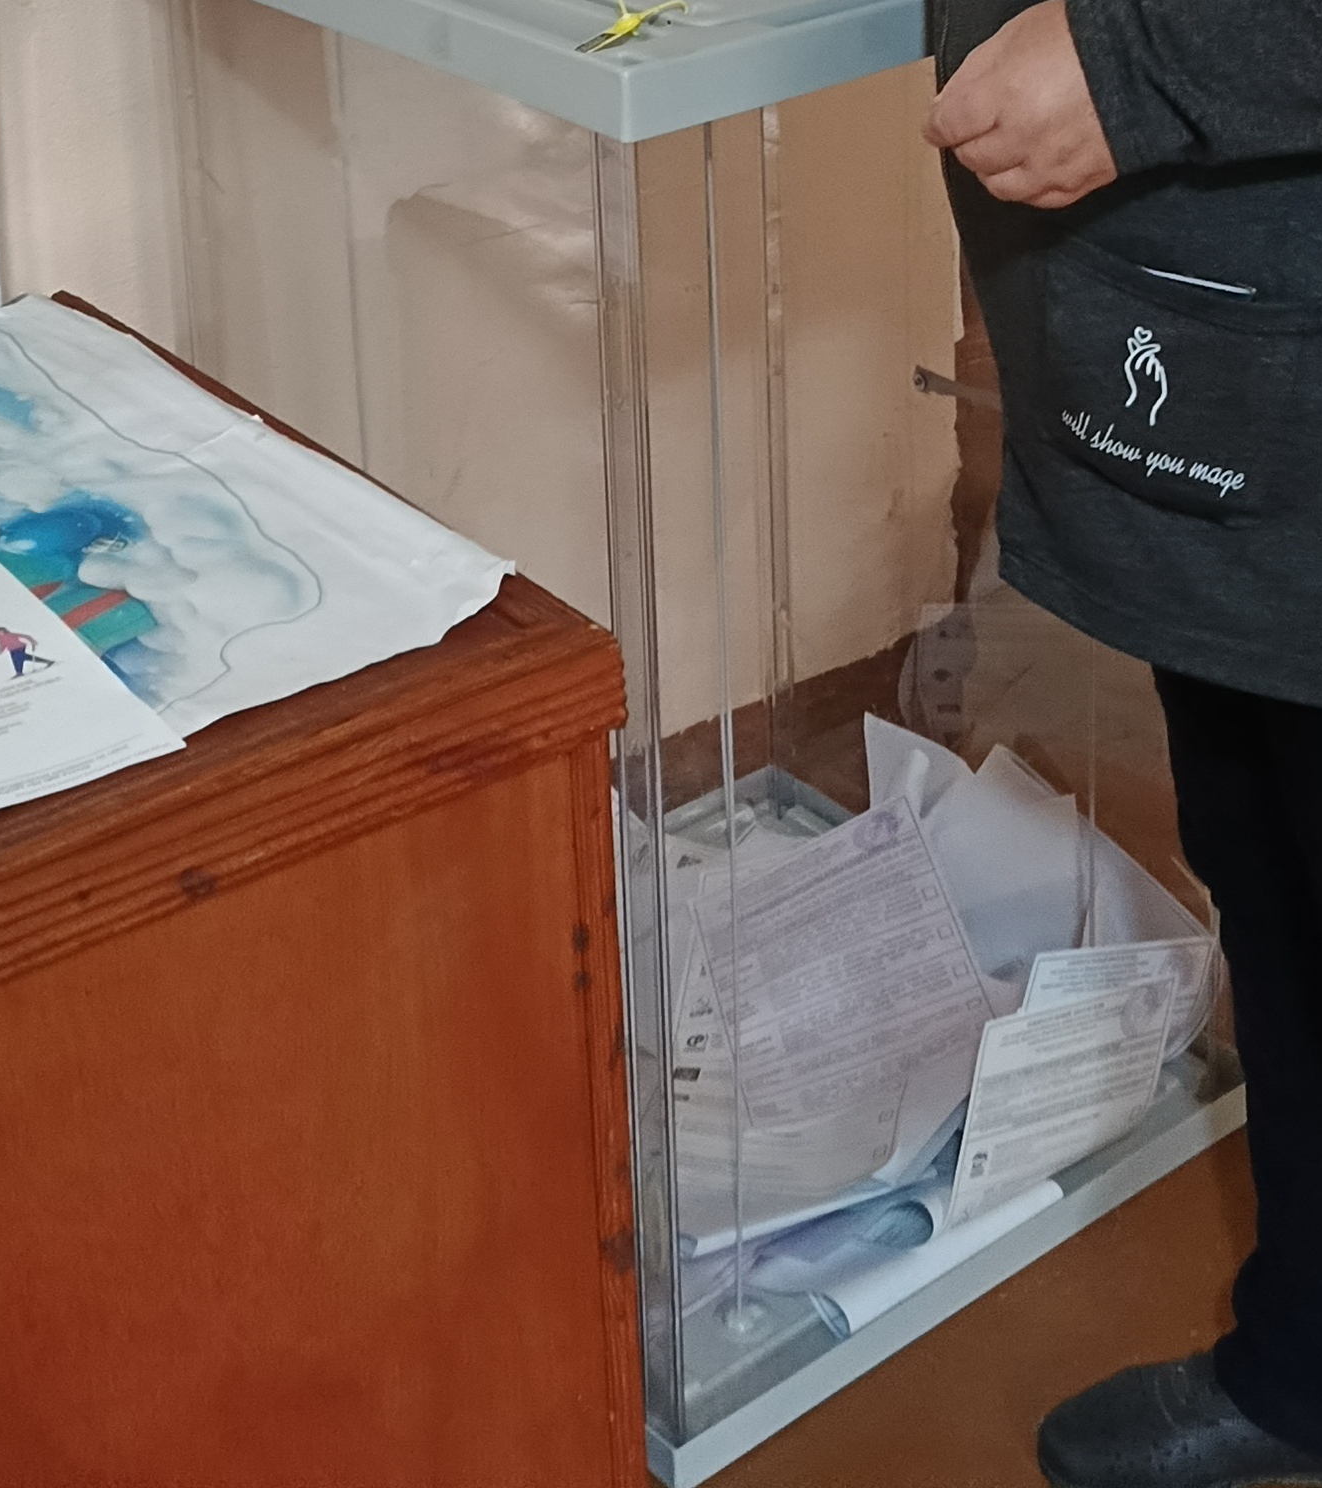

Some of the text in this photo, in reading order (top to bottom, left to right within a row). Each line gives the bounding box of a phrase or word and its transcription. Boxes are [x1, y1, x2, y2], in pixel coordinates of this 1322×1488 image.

[1061, 409, 1245, 498] will show you mage
